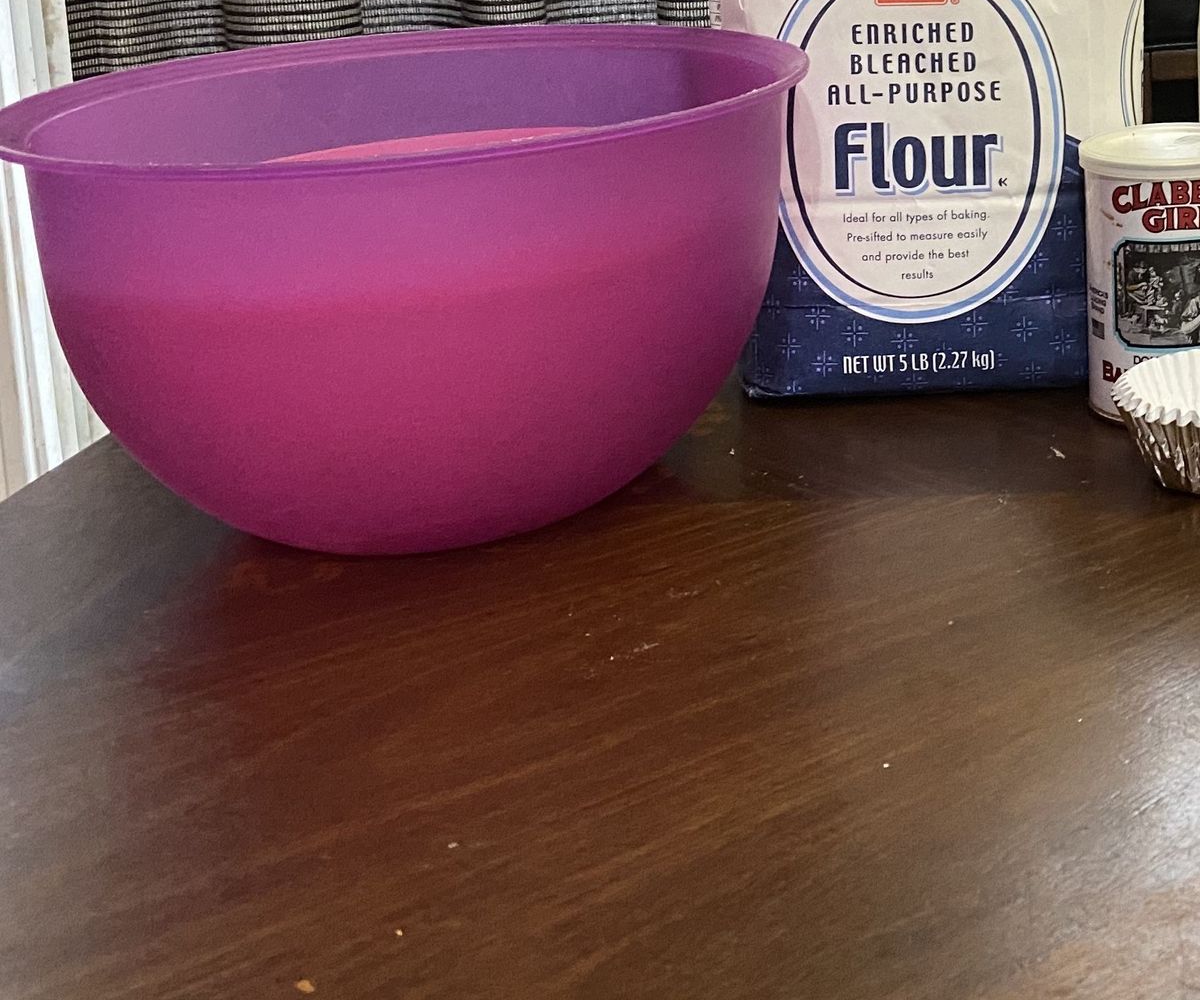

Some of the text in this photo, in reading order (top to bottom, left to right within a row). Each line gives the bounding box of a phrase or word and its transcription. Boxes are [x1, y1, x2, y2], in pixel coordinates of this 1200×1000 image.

[851, 22, 974, 45] ENRICHED
[850, 51, 977, 75] BLEACHED
[827, 80, 1002, 106] ALL-PURPOSE
[843, 212, 868, 223] Ideal
[872, 212, 886, 222] for
[889, 211, 902, 222] all
[906, 213, 933, 224] types
[936, 210, 949, 221] of
[846, 228, 988, 242] Pre-sifted to measure easily
[861, 249, 969, 263] and provide the best
[901, 269, 934, 280] results
[843, 349, 995, 374] NET WT 5 LB (2.27 kg)
